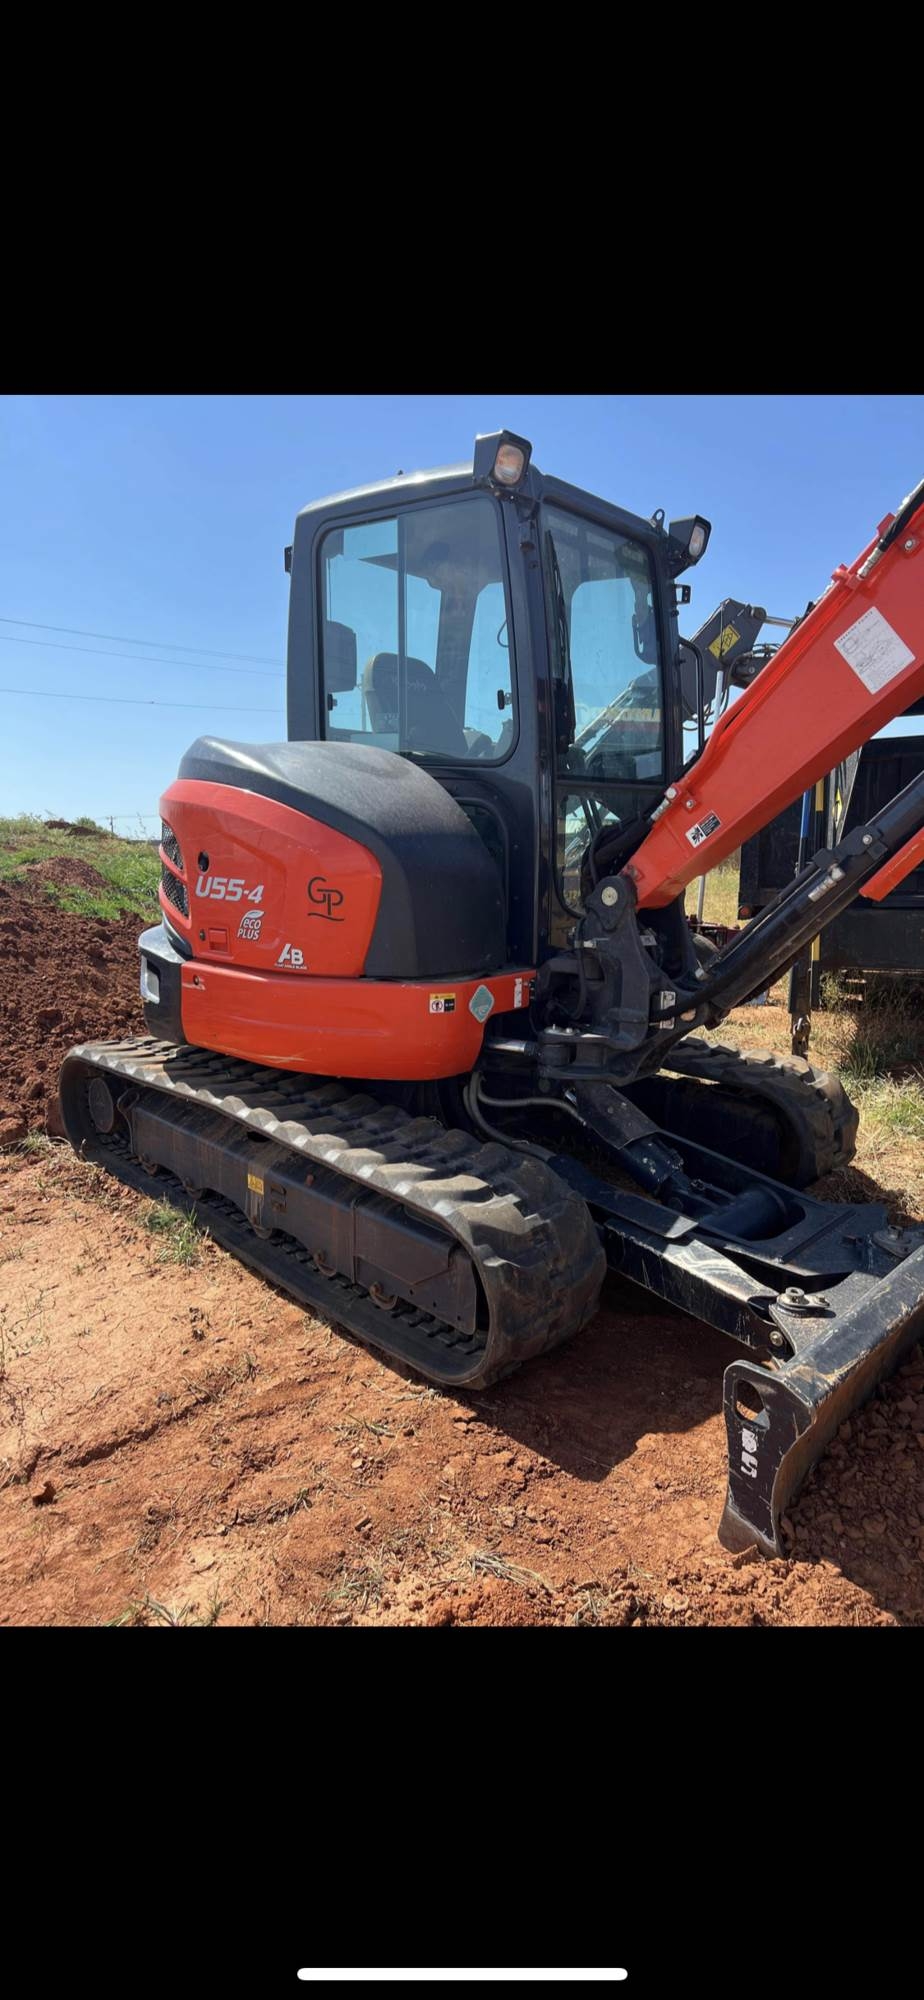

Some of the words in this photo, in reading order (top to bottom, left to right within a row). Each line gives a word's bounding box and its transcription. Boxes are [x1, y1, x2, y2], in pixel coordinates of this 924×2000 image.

[195, 875, 264, 904] U55-4
[243, 918, 262, 930] eco
[237, 928, 260, 940] PLUS
[277, 943, 304, 965] AB
